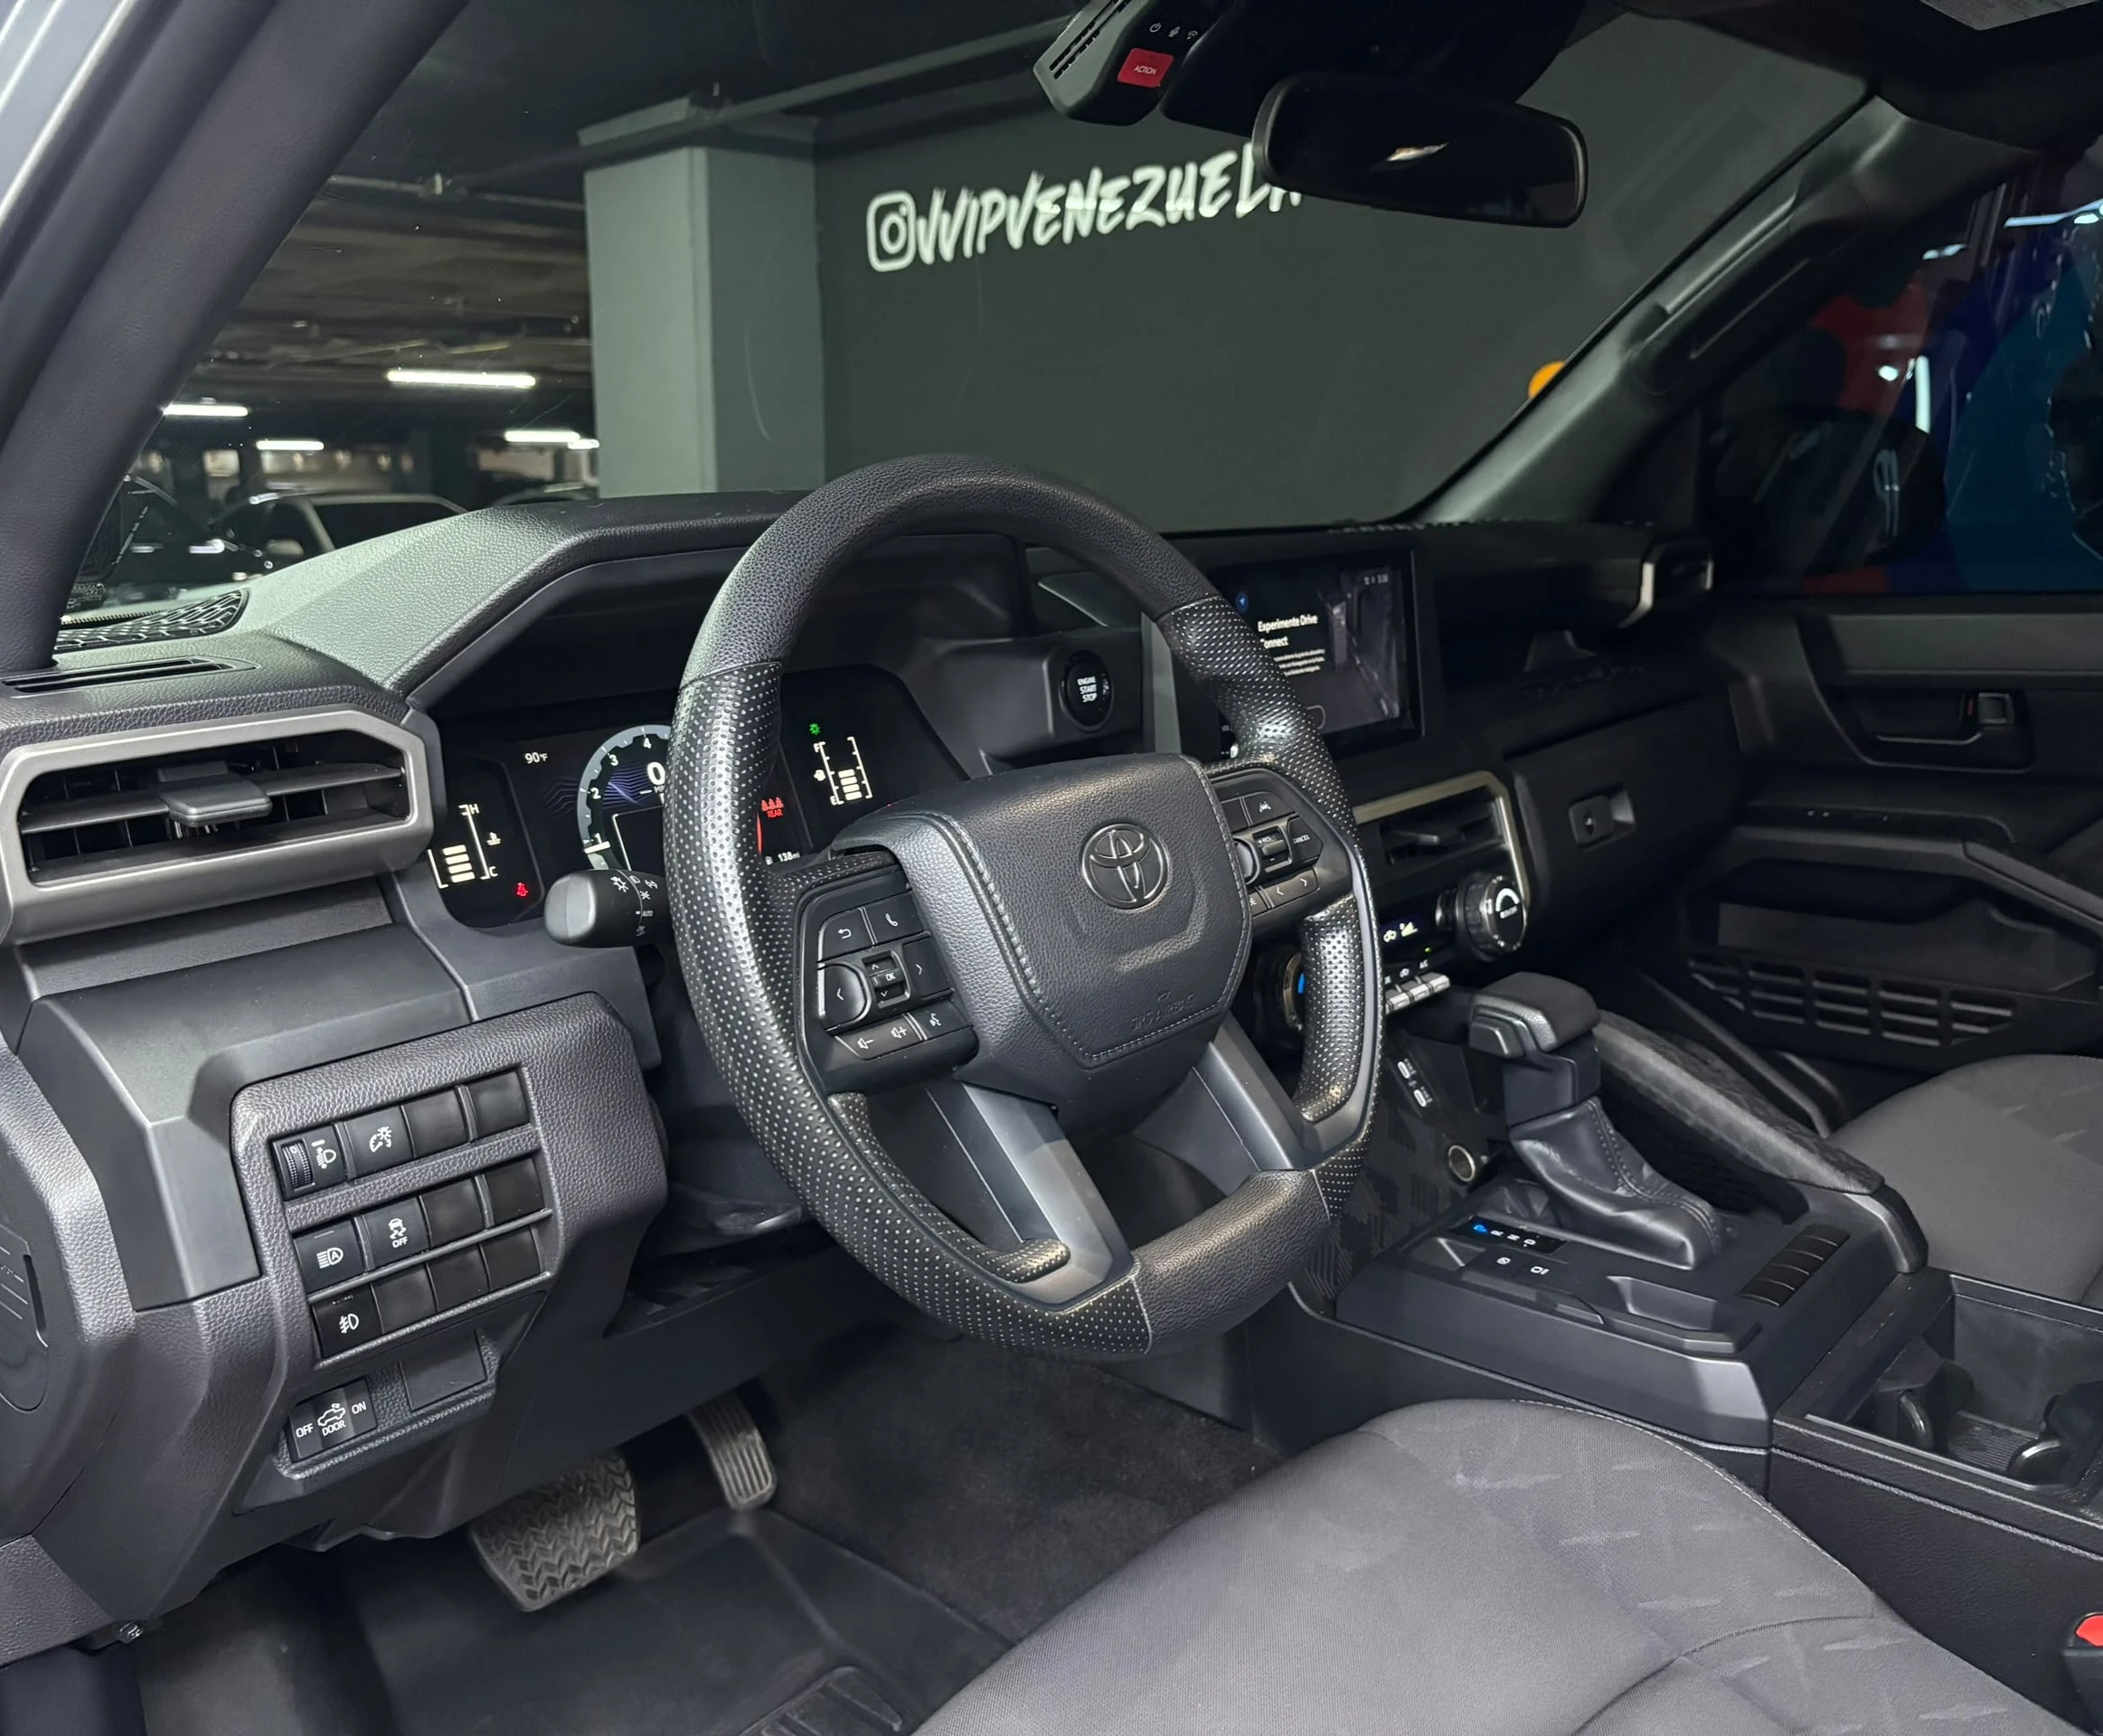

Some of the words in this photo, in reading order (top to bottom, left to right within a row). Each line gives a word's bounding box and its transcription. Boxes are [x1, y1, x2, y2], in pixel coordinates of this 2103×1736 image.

[1134, 65, 1158, 75] ACTION
[1258, 618, 1300, 633] Experimente
[1300, 614, 1318, 626] Drive
[1260, 637, 1289, 649] onnect
[1082, 693, 1097, 703] STOP
[643, 737, 652, 750] 4
[608, 754, 619, 767] 3
[589, 787, 601, 800] 2
[469, 804, 480, 815] H
[767, 809, 783, 817] REAR
[489, 866, 498, 877] C
[391, 1236, 409, 1249] OFF
[351, 1401, 367, 1415] ON
[296, 1422, 314, 1438] OFF
[321, 1420, 346, 1437] DOOR
